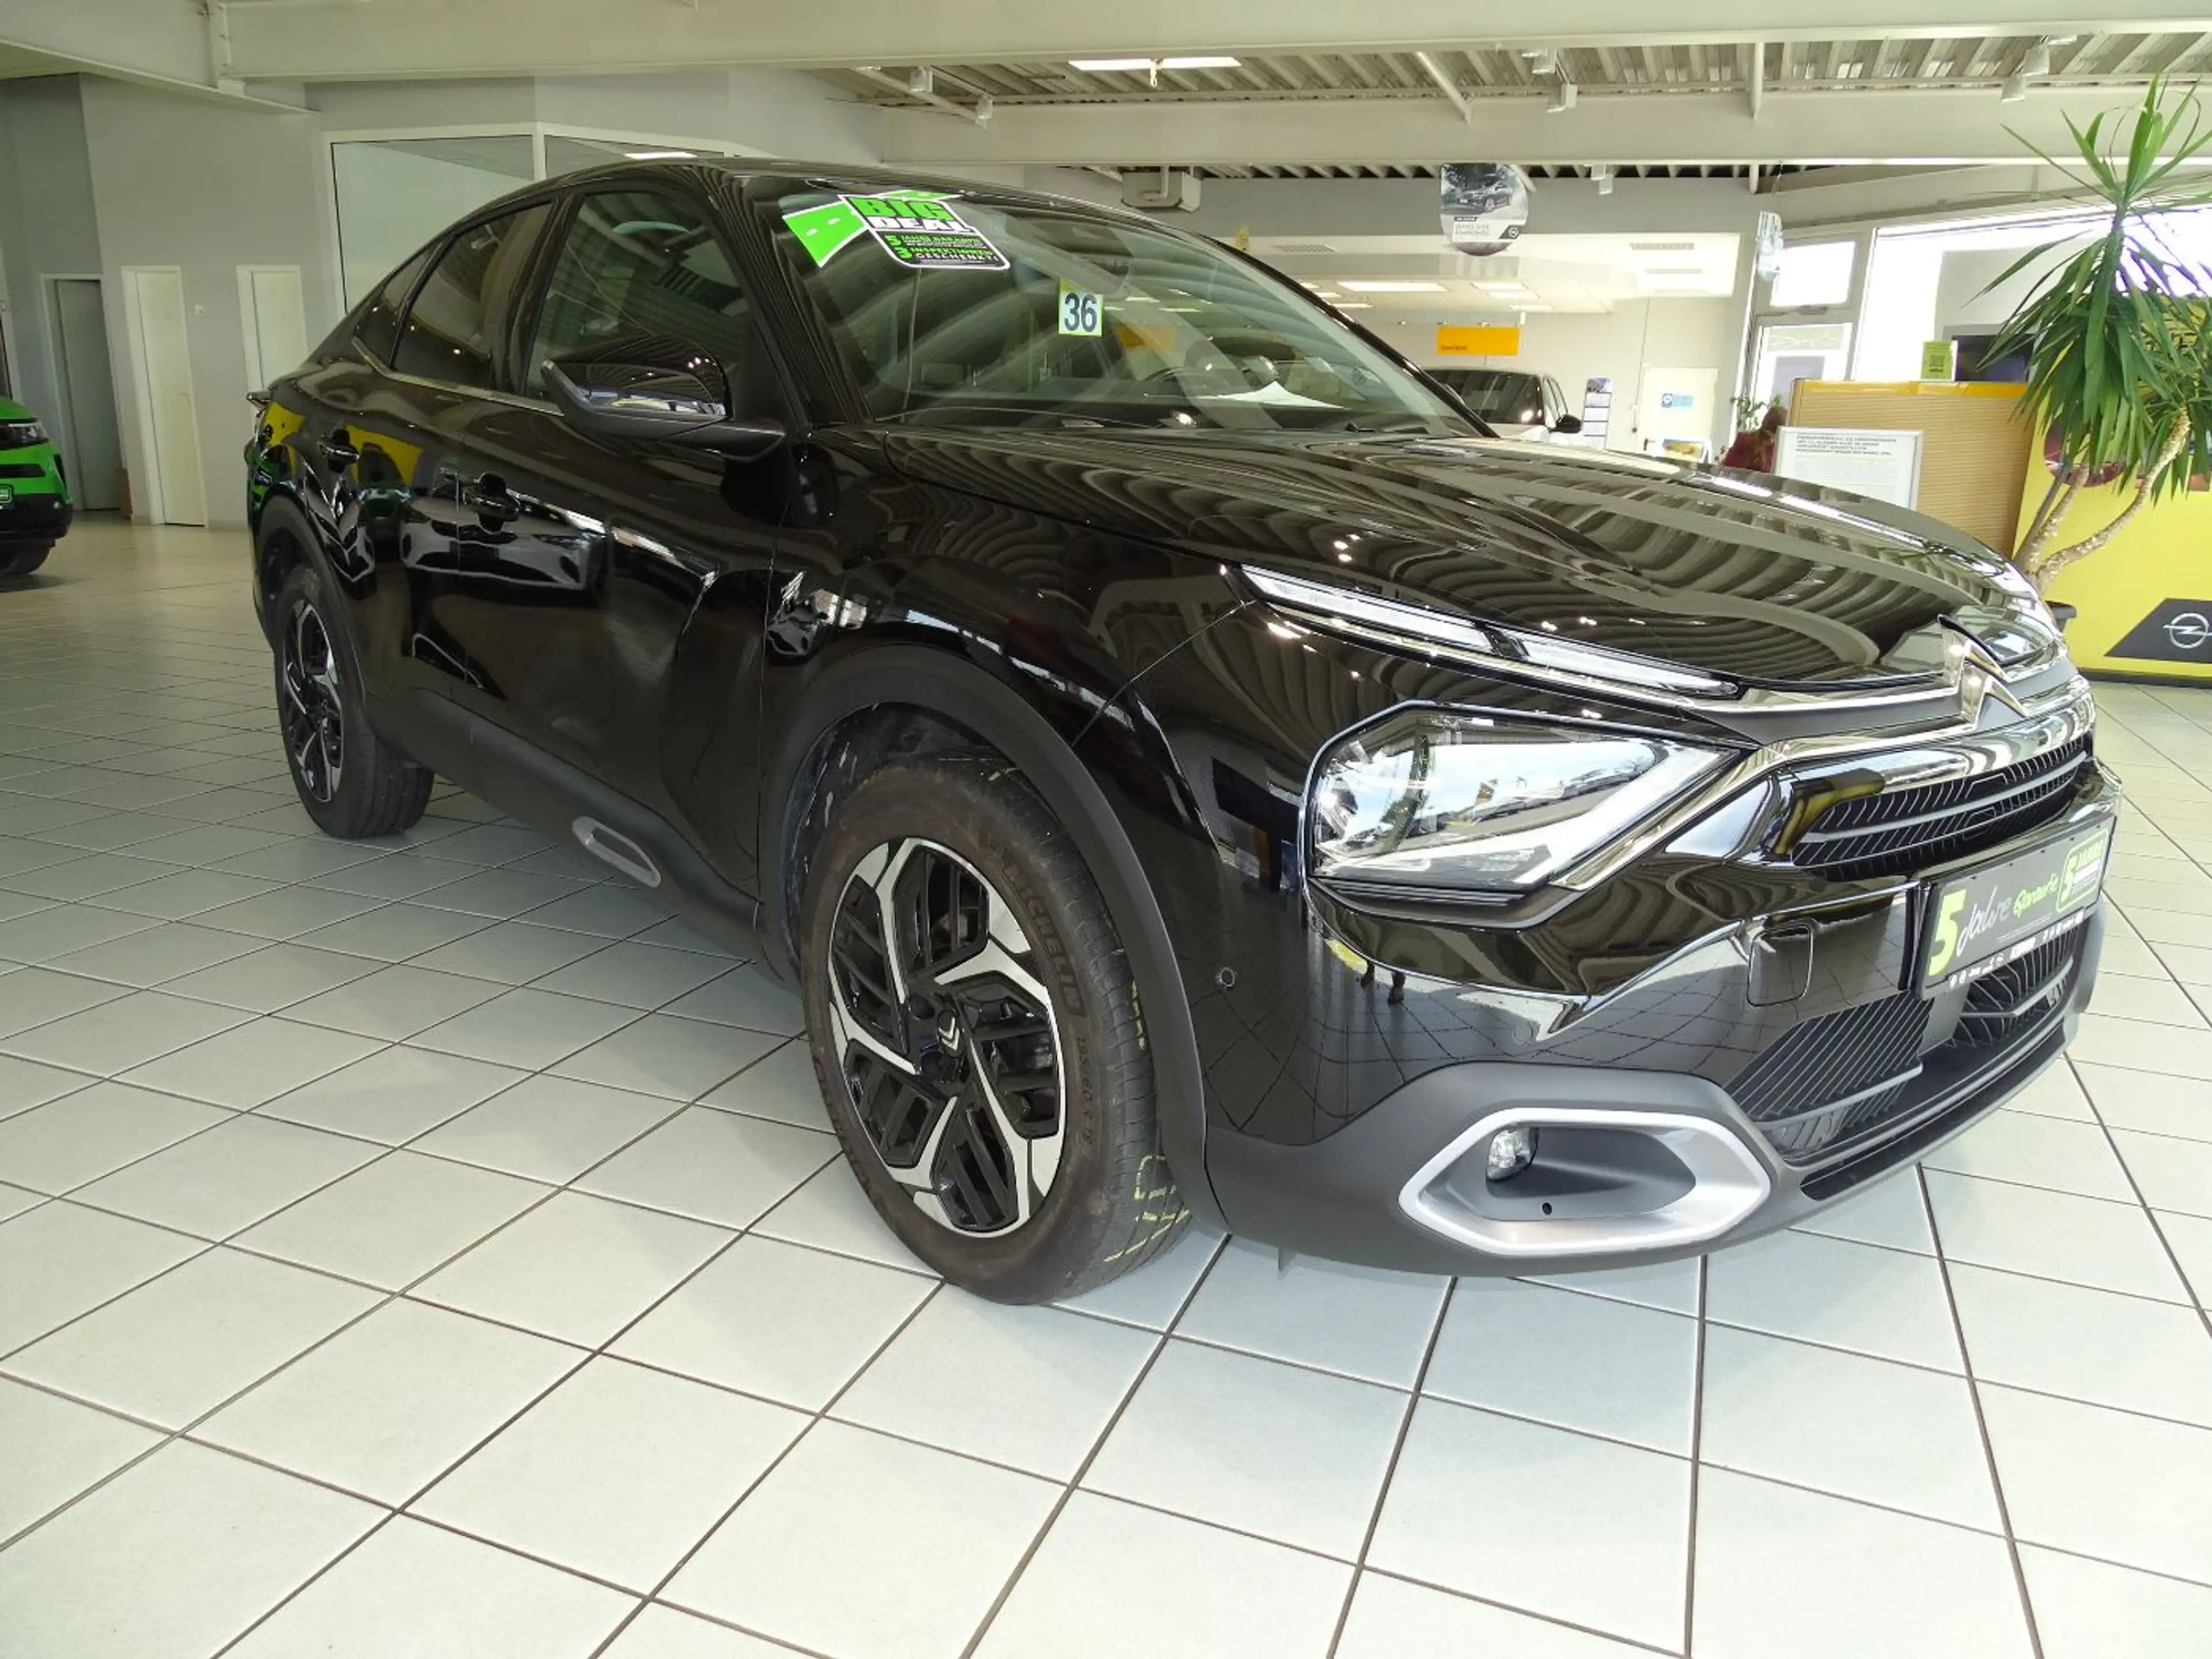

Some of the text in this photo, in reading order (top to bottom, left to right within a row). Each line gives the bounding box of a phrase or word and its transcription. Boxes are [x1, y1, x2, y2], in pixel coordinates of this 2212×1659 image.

[851, 198, 953, 221] BIG
[867, 217, 971, 232] DEAL
[885, 235, 902, 246] 5
[895, 247, 912, 259] 3
[1065, 292, 1097, 332] 36
[1003, 863, 1086, 1016] MICHELIN
[1929, 889, 1966, 976] 5
[1956, 885, 2012, 957] Jahre
